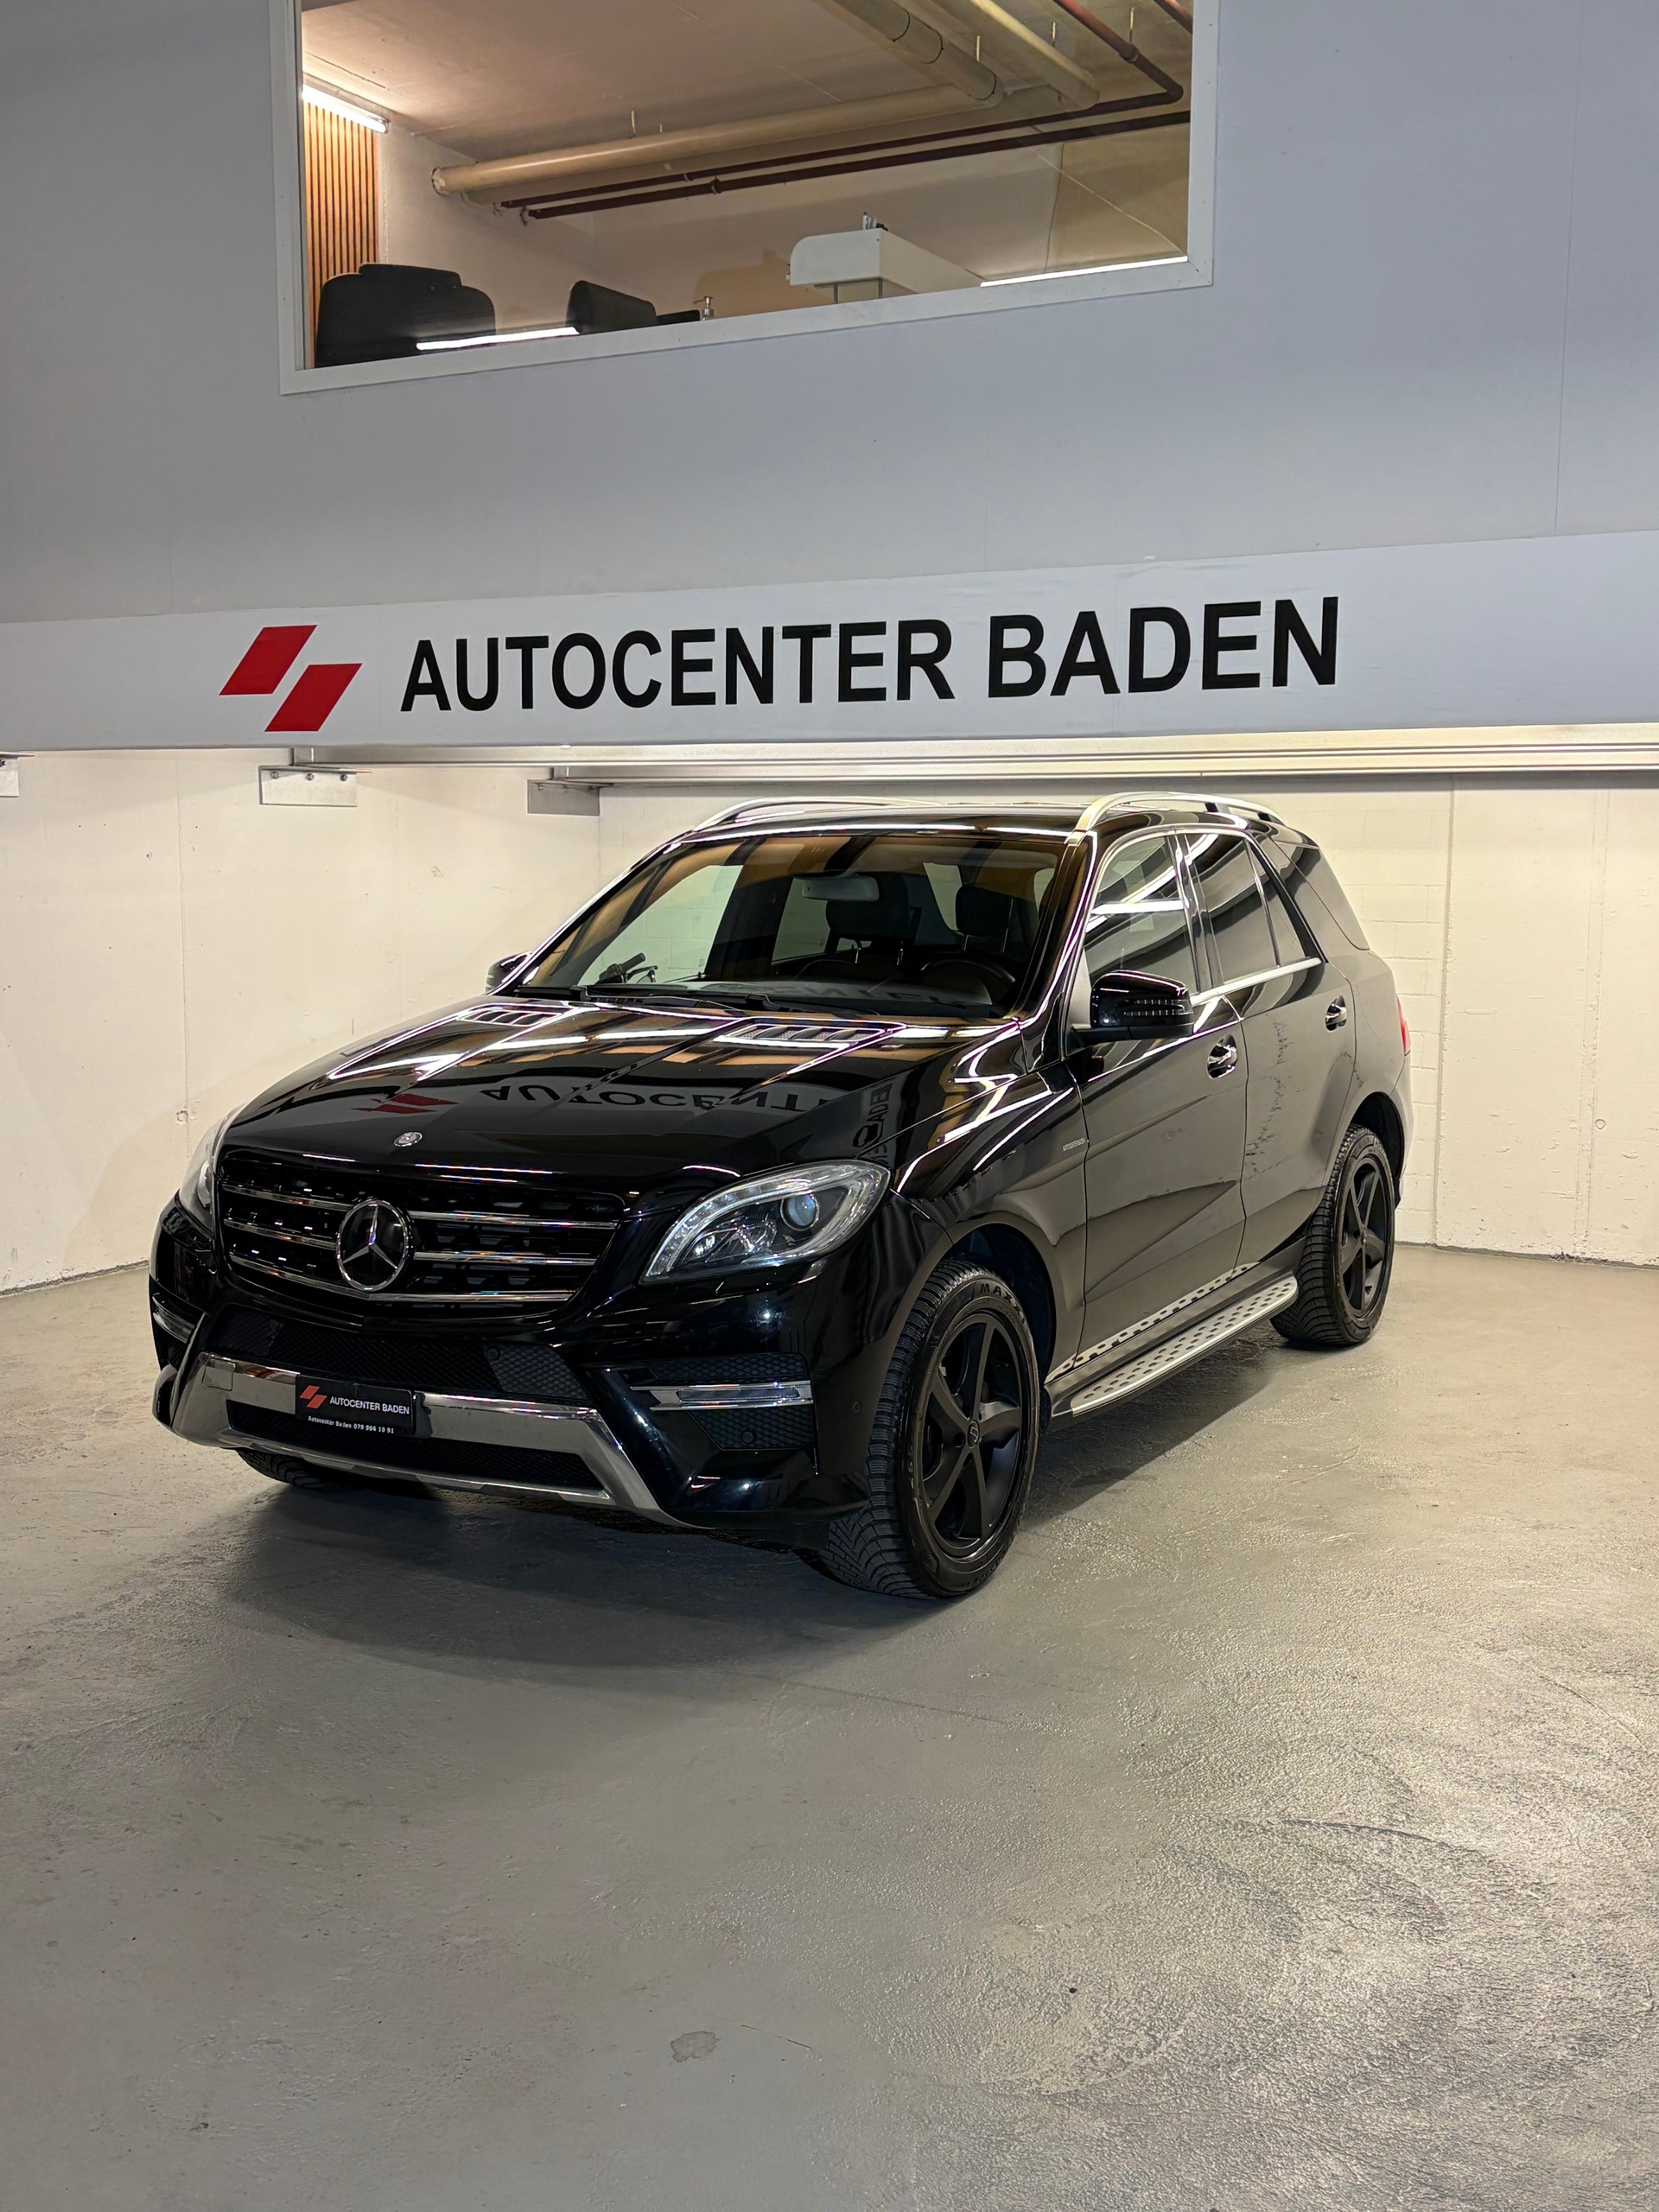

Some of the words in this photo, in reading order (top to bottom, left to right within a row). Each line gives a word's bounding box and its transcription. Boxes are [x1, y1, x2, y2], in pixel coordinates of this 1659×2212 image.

[400, 619, 956, 712] AUTOCENTER
[988, 596, 1339, 698] BADEN
[329, 1396, 380, 1411] AUTOCENTER
[383, 1403, 410, 1414] BADEN
[308, 1415, 334, 1426] Autocenter
